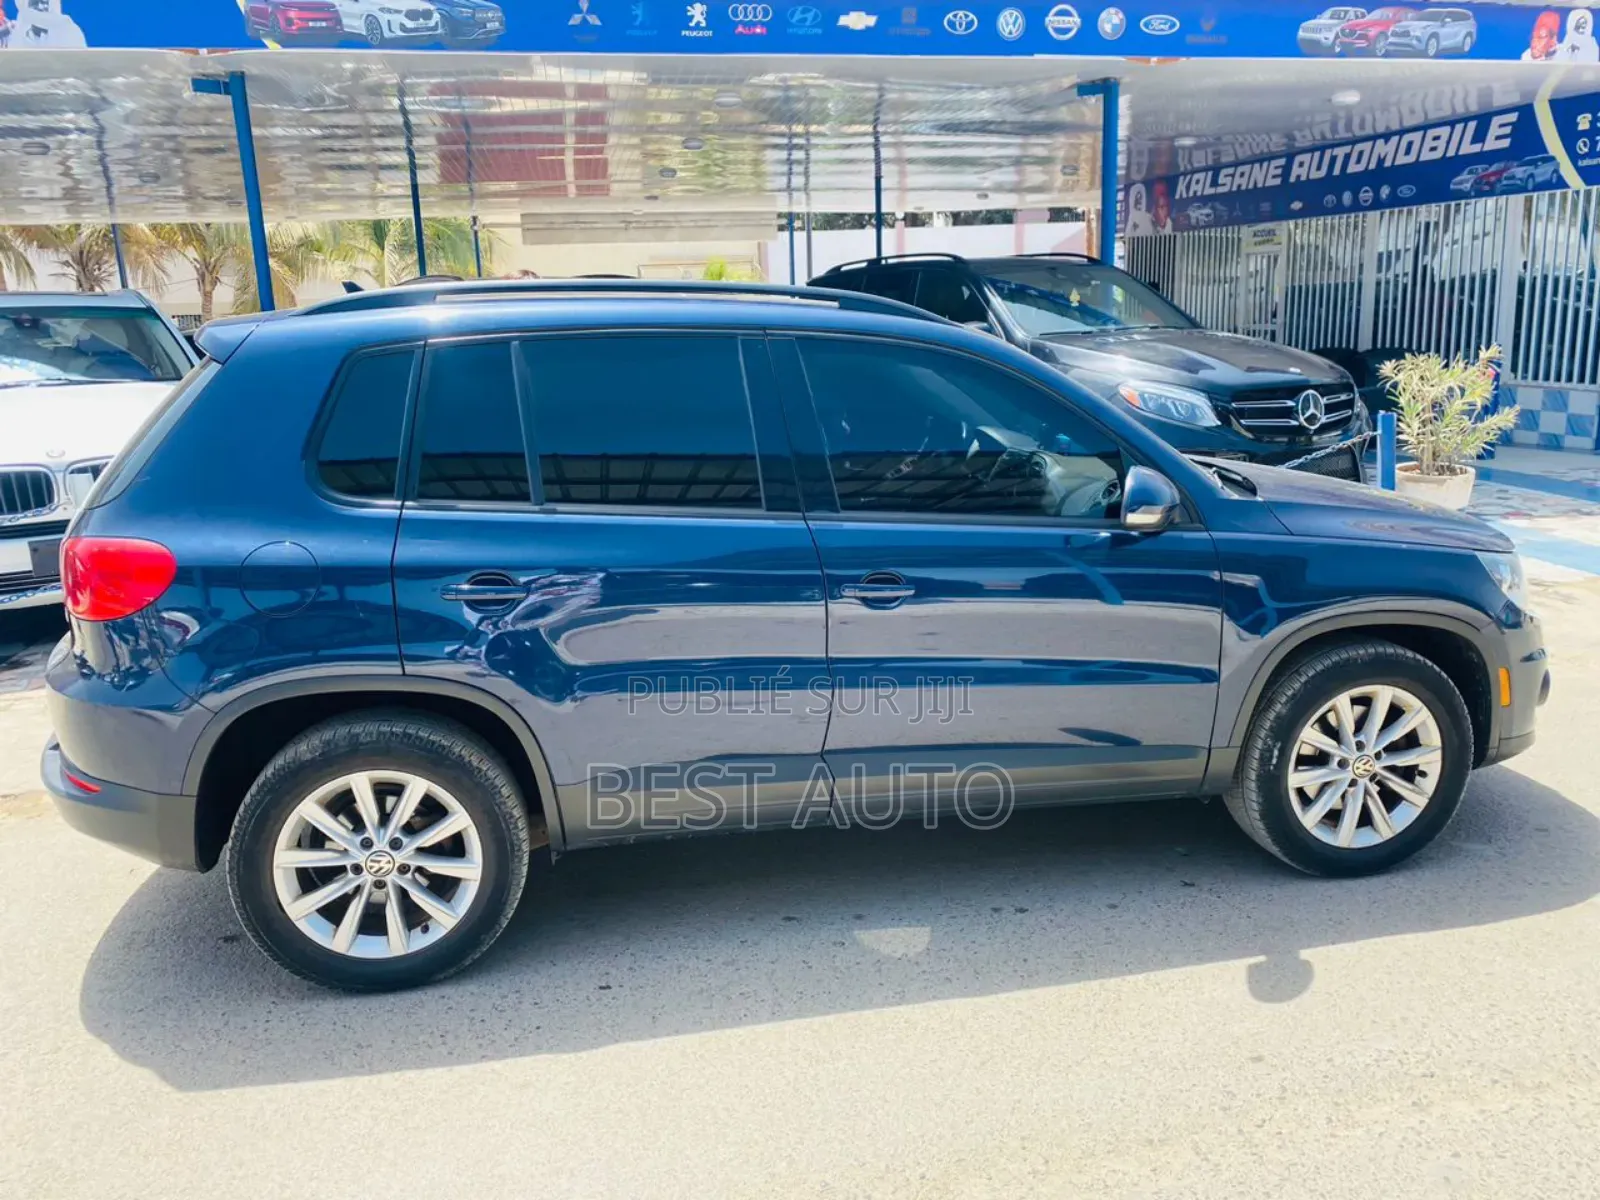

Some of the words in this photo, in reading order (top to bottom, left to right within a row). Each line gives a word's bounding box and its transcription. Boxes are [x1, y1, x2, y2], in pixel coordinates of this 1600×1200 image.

[734, 24, 768, 35] Audi
[1175, 157, 1287, 200] KALSANE
[1289, 111, 1520, 183] AUTOMOBILE
